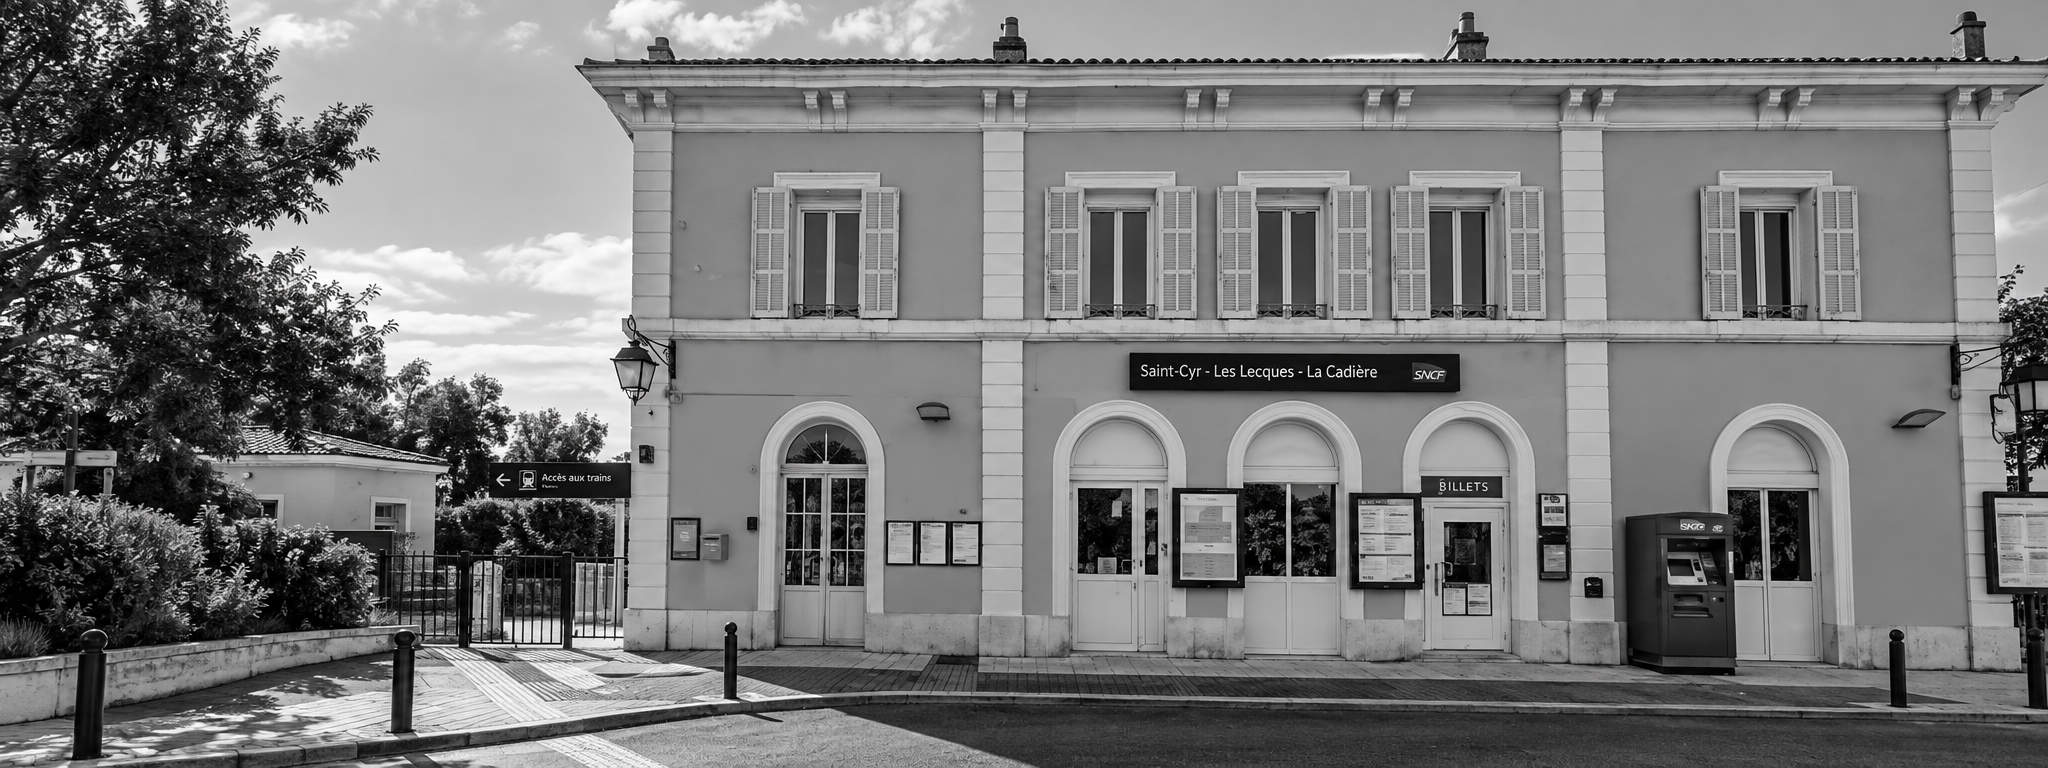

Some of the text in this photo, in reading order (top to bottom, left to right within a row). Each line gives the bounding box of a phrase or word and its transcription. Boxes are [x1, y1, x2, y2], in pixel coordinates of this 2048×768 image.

[1140, 364, 1202, 381] Saint-Cyr
[1214, 364, 1236, 378] Les
[1240, 364, 1295, 381] Lecques
[1307, 365, 1322, 378] La
[1326, 364, 1378, 379] Cadière
[1413, 370, 1446, 380] SNCF
[541, 473, 567, 482] Accès
[587, 473, 612, 482] trains
[1439, 481, 1489, 492] BILLETS
